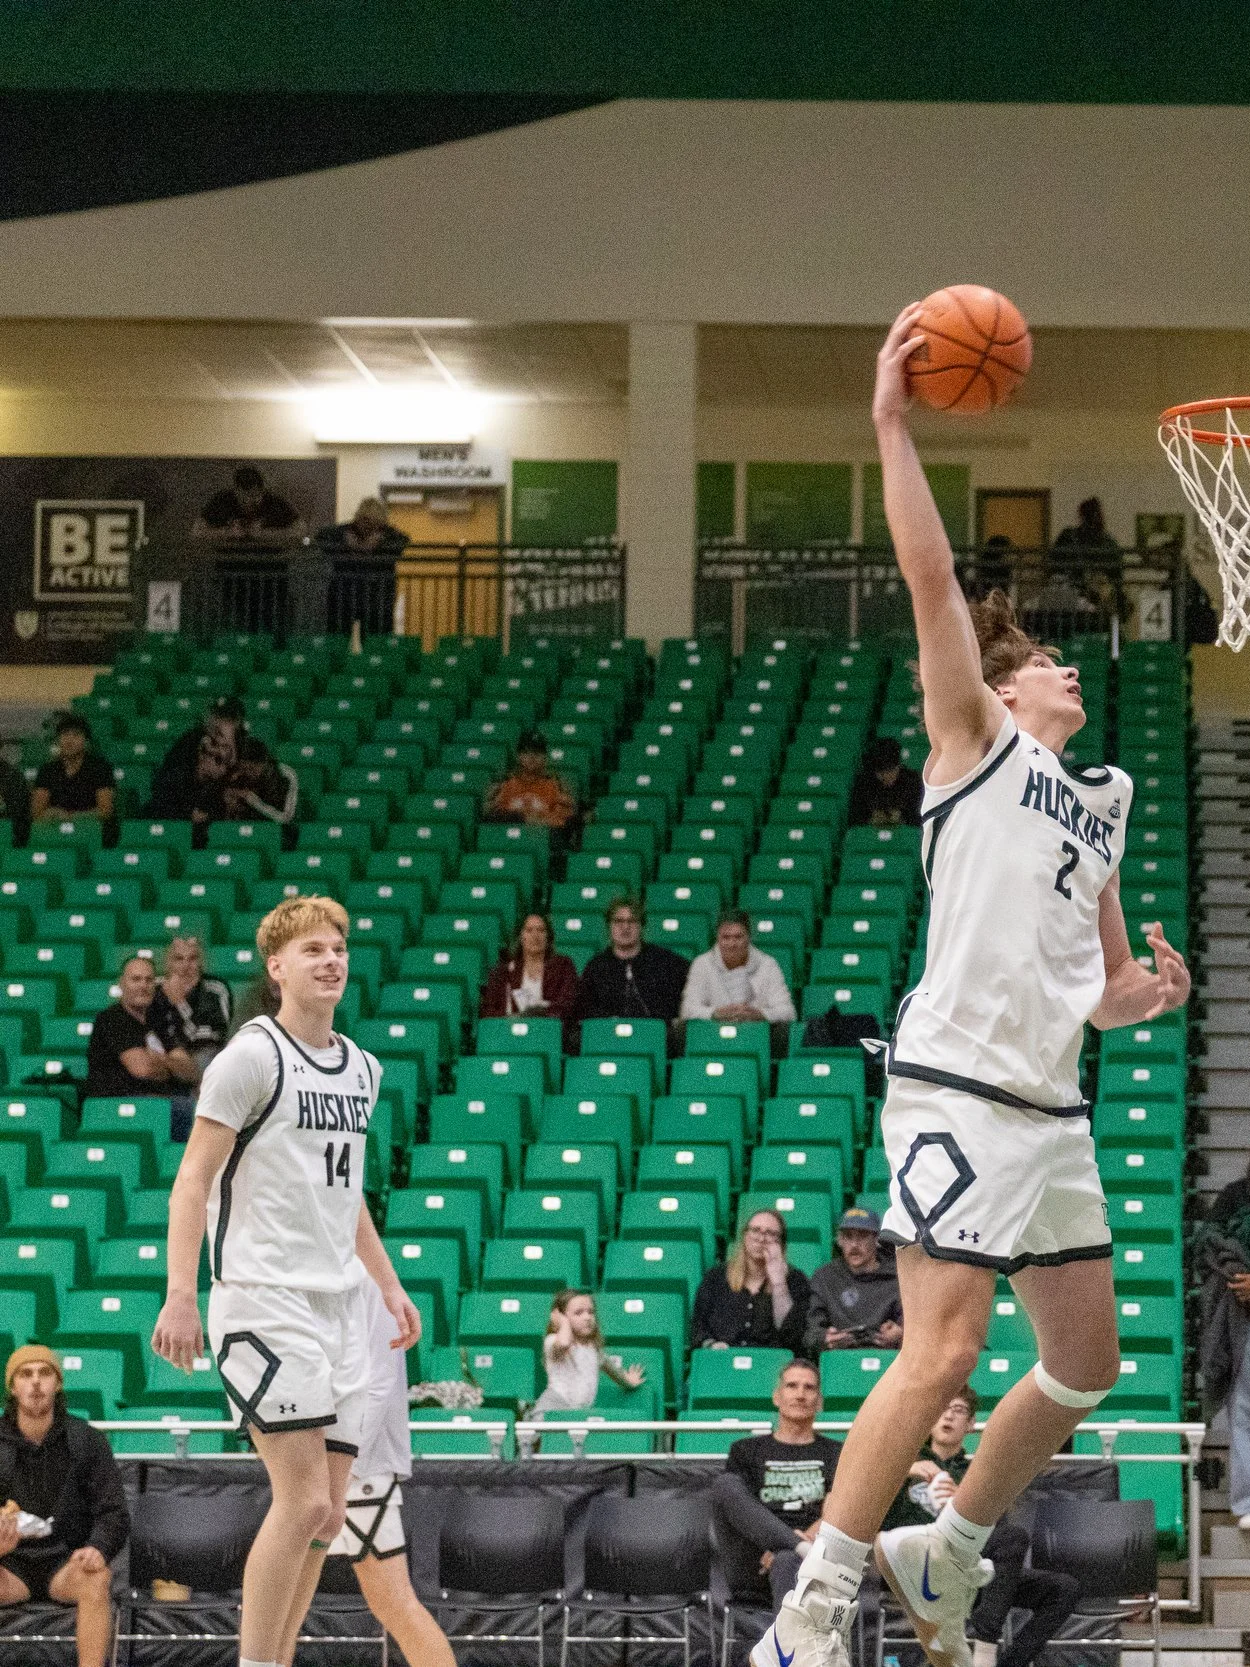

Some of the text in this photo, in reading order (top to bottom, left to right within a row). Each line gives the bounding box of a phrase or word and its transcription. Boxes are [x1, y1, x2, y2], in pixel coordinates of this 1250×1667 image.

[394, 466, 492, 479] WASHROOM
[50, 514, 130, 565] BE
[50, 566, 130, 588] ACTIVE
[153, 594, 172, 620] 4
[1145, 600, 1165, 629] 4
[1020, 766, 1115, 866] HUSKIES
[1054, 840, 1080, 900] 2
[297, 1090, 370, 1135] HUSKIES
[324, 1142, 351, 1187] 14
